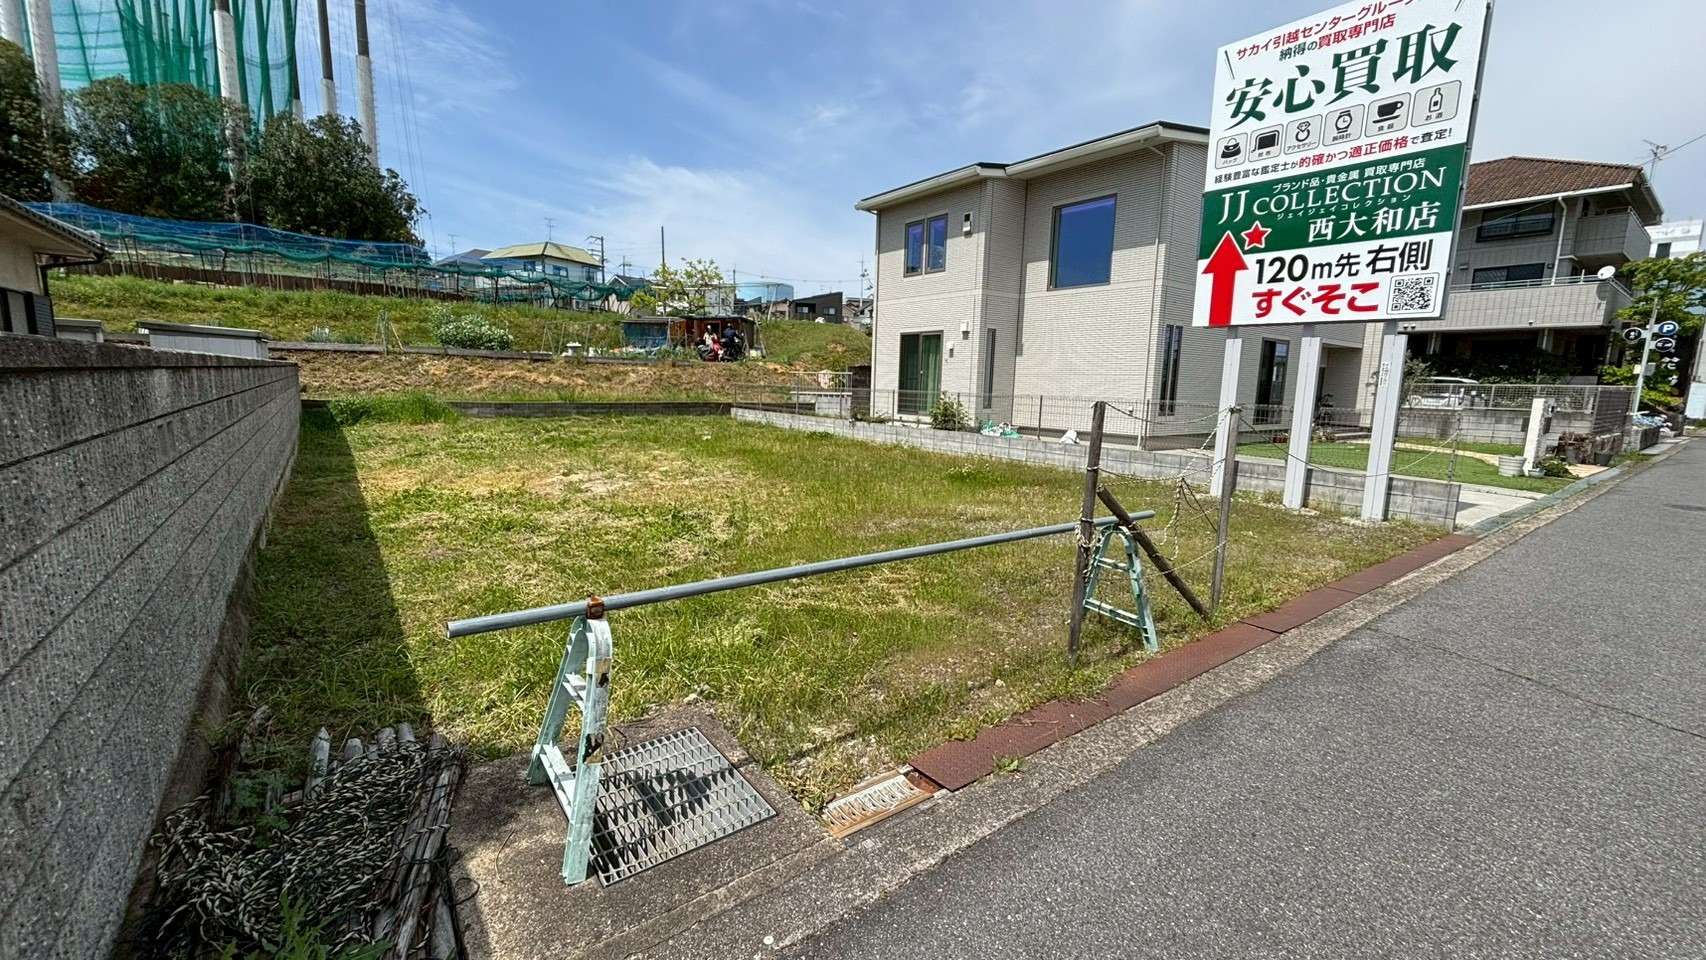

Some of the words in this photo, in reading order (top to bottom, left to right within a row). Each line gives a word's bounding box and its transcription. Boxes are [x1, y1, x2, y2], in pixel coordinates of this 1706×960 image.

[1236, 0, 1414, 61] サカイ引越センターグルー
[1278, 13, 1396, 61] 納得の買取専門店
[1223, 22, 1463, 131] 安心買取
[1364, 157, 1427, 178] 買取専門店
[1217, 190, 1250, 225] JJ
[1253, 166, 1448, 216] COLLECTION
[1276, 194, 1411, 220] ジェイジェイコレクション
[1307, 201, 1441, 243] 西大和店
[1251, 281, 1380, 318] すぐそこ
